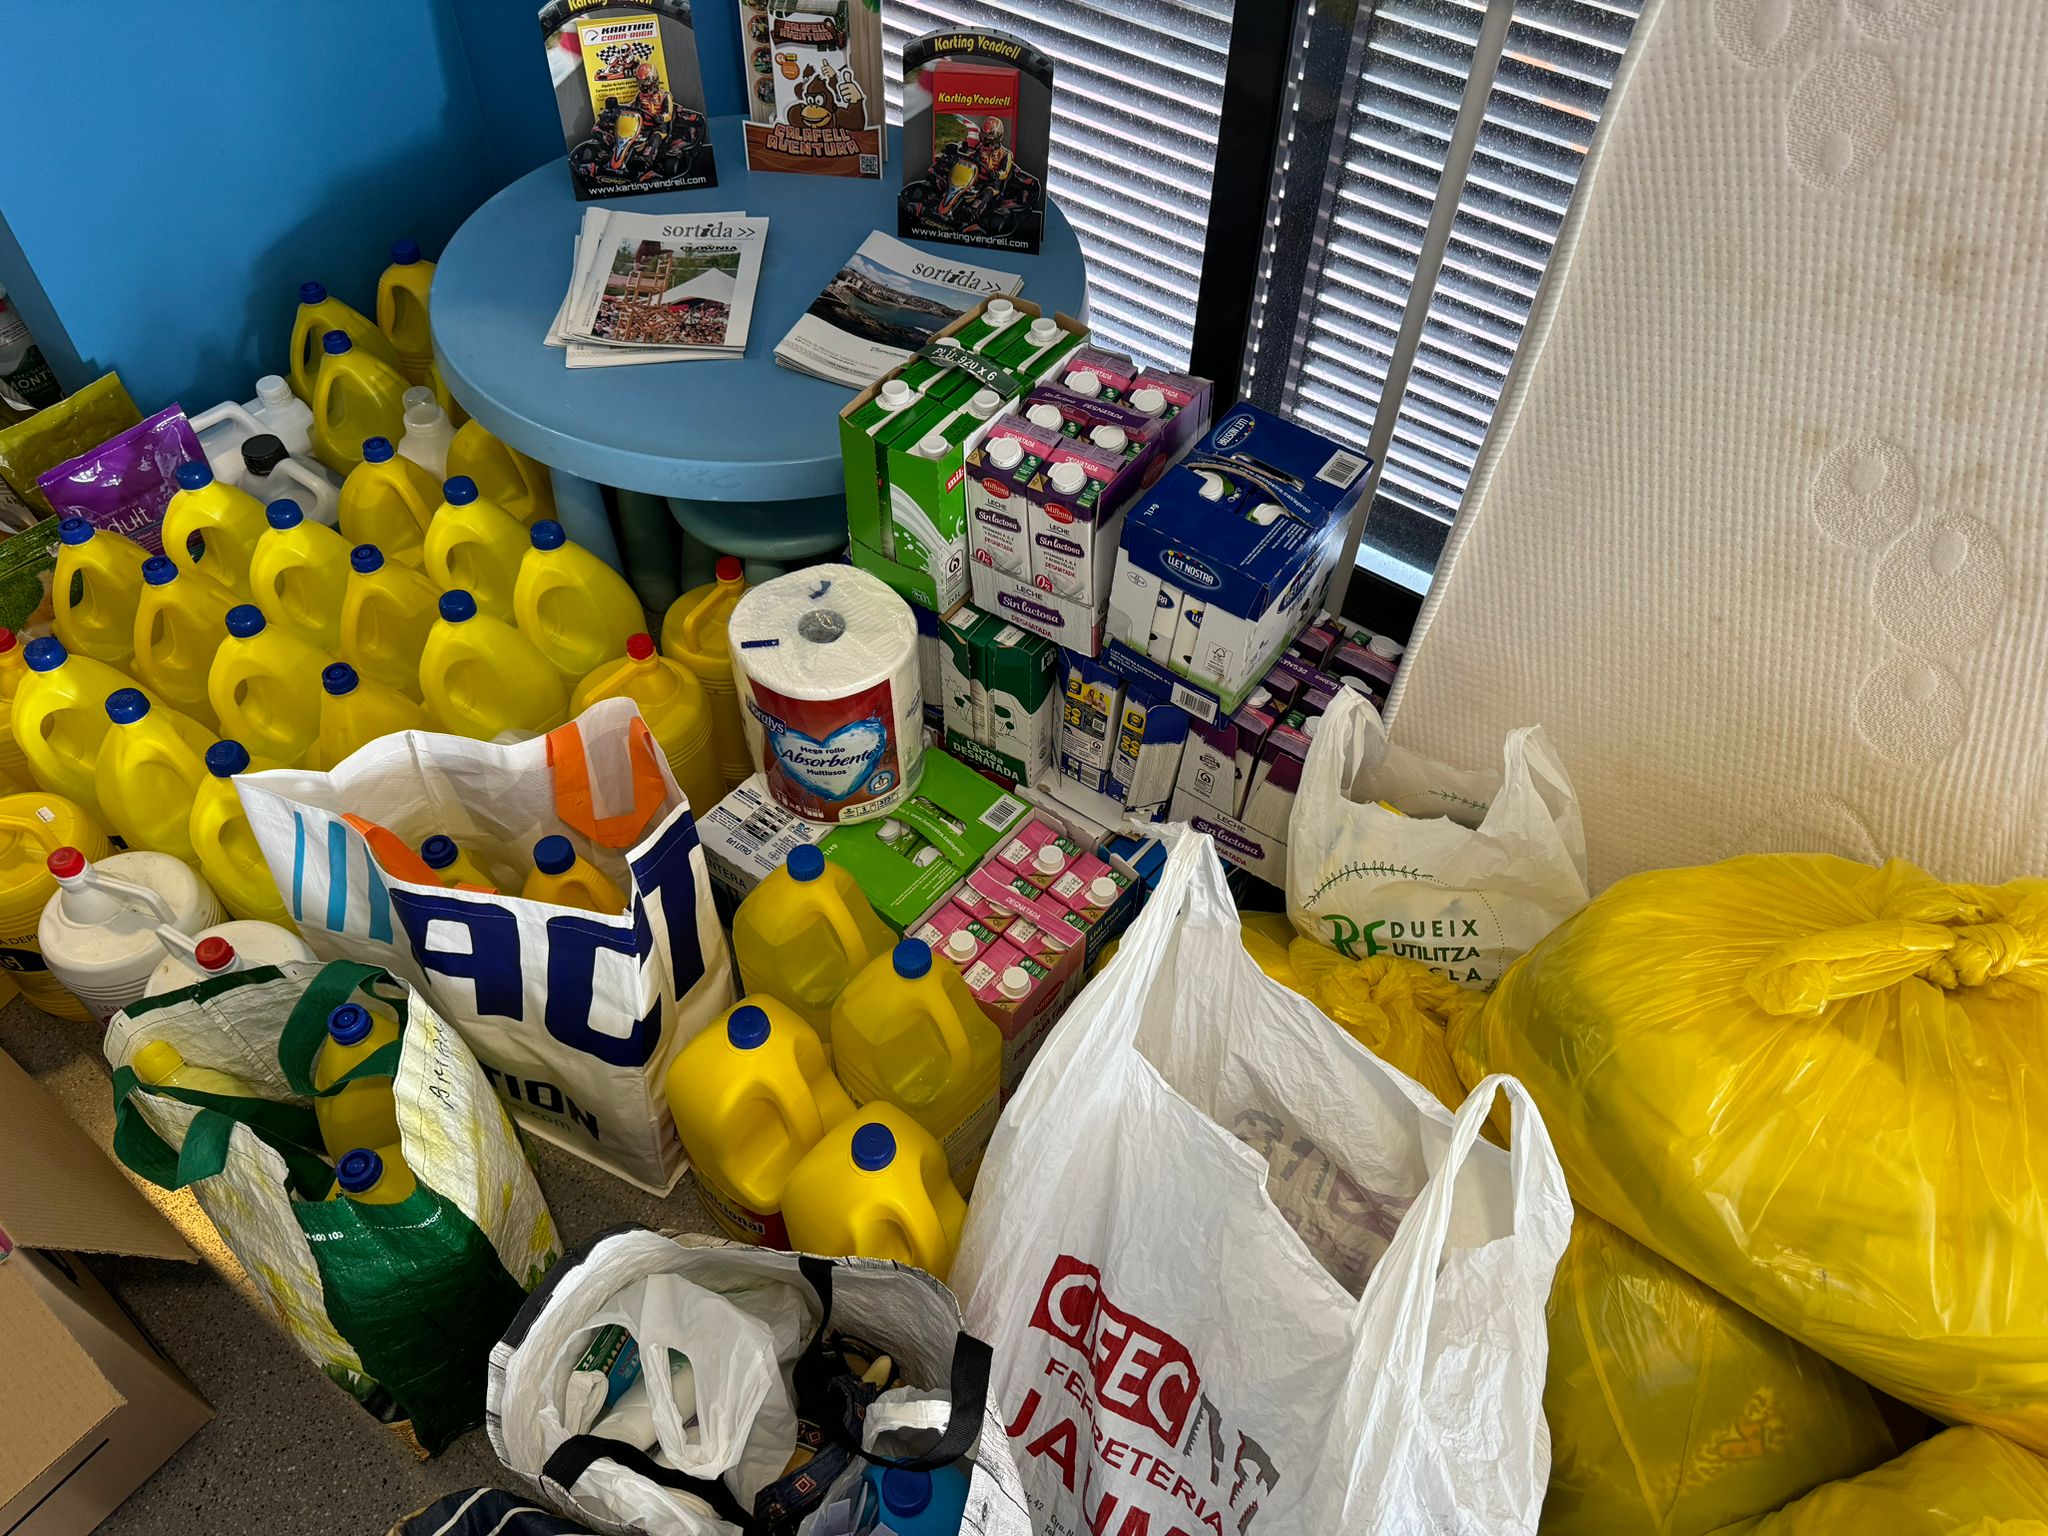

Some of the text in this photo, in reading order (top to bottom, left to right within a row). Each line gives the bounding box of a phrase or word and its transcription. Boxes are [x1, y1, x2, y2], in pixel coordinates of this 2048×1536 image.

[602, 22, 654, 34] KARTING
[779, 28, 834, 41] AVENTURA
[783, 22, 827, 32] CALAFELL
[934, 36, 1021, 60] Karting Vendrell
[774, 125, 850, 142] CALAFELL
[766, 136, 860, 156] AVENTURA
[589, 176, 706, 195] www.kartingvendrell.com
[662, 222, 732, 238] sortida
[912, 226, 1029, 248] www.kartingvendrell.com
[912, 262, 981, 290] sortida
[957, 355, 977, 370] 920
[988, 371, 998, 382] 6
[1082, 403, 1124, 420] DESNATADA
[984, 481, 1009, 496] Milbona
[988, 499, 1007, 511] LECHE
[1046, 505, 1073, 520] Milbona
[1050, 524, 1070, 536] LECHE
[1045, 562, 1075, 578] DESNATADA
[1168, 556, 1214, 586] LLET NOSTRA
[1016, 584, 1043, 600] LECHE
[1011, 614, 1052, 638] DESNATADA
[780, 748, 877, 768] Absorbente
[800, 746, 846, 754] Mega rollo
[954, 741, 1020, 782] DESNATADA
[806, 768, 847, 776] Multiusos
[1217, 814, 1246, 834] LECHE
[735, 842, 752, 856] LITRO
[1005, 896, 1040, 920] DESNATADA
[1390, 919, 1480, 939] DUEIX
[1392, 943, 1481, 962] UTILITZA
[328, 1232, 344, 1240] 103
[1033, 1500, 1044, 1512] 42
